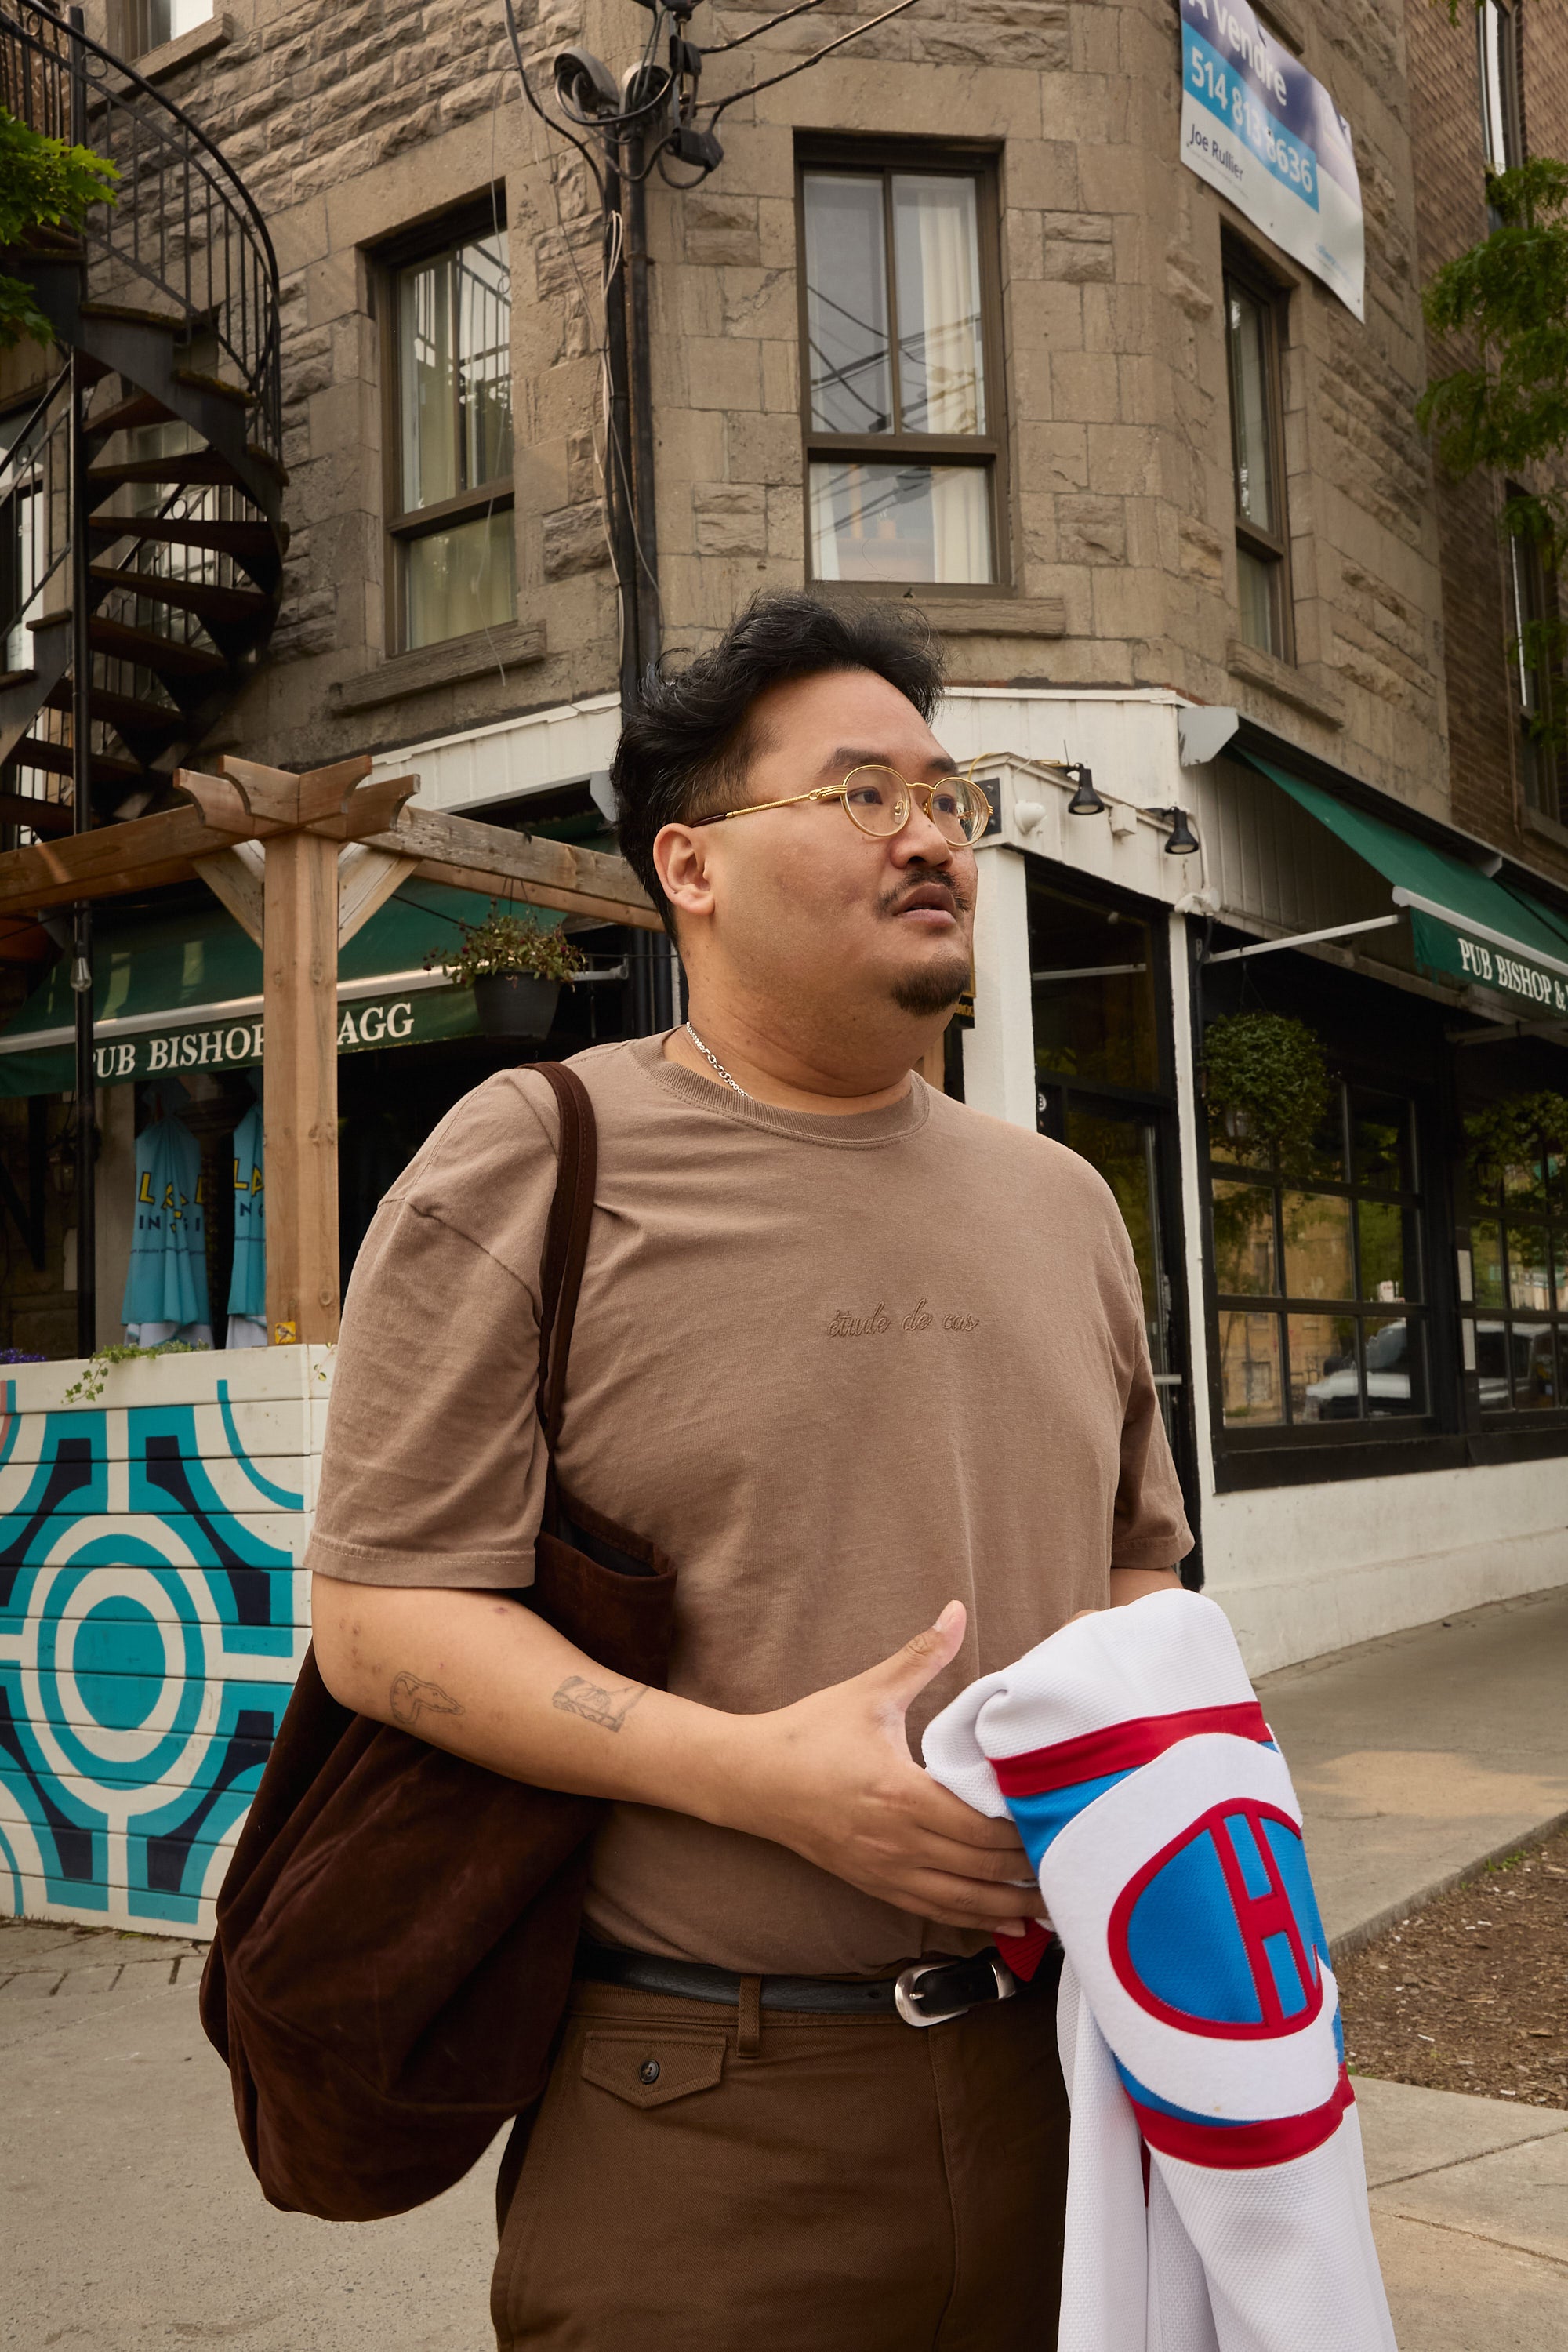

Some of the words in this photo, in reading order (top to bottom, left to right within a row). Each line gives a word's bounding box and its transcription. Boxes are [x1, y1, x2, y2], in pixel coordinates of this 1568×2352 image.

[1192, 46, 1228, 110] 514
[1189, 123, 1209, 152] Joe
[1212, 140, 1244, 181] Rullier
[1457, 938, 1493, 980] PUB
[1494, 954, 1552, 1005] BISHOP
[1554, 980, 1566, 1011] &
[93, 1044, 136, 1078] UB
[337, 1003, 415, 1045] AGG
[826, 1300, 891, 1338] étude
[902, 1298, 933, 1332] de
[942, 1312, 980, 1332] cas
